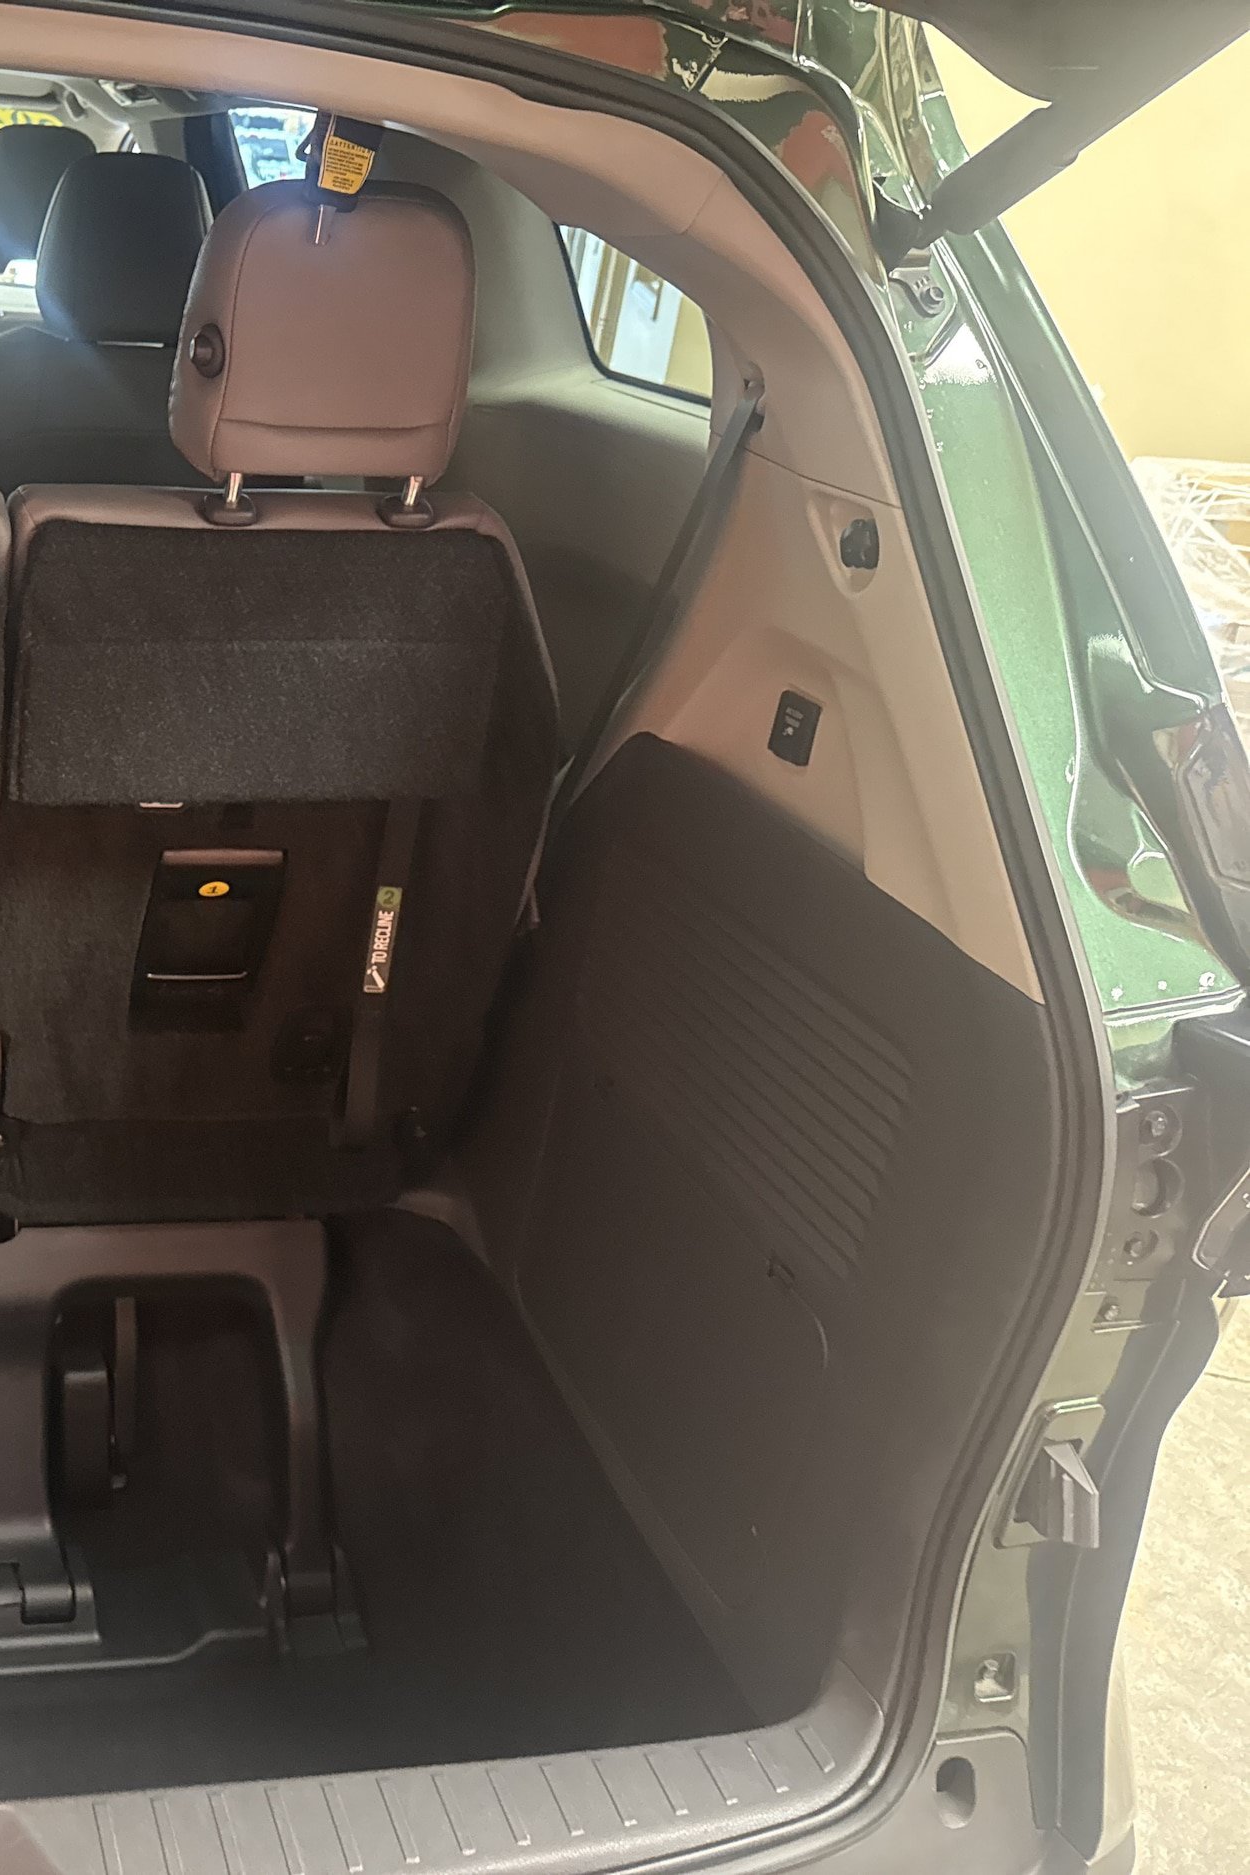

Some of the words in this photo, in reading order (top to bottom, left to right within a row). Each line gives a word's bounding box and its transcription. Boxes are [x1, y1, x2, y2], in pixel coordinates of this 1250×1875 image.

[383, 889, 394, 904] 2
[373, 910, 394, 950] RECLINE
[371, 951, 388, 964] TO
